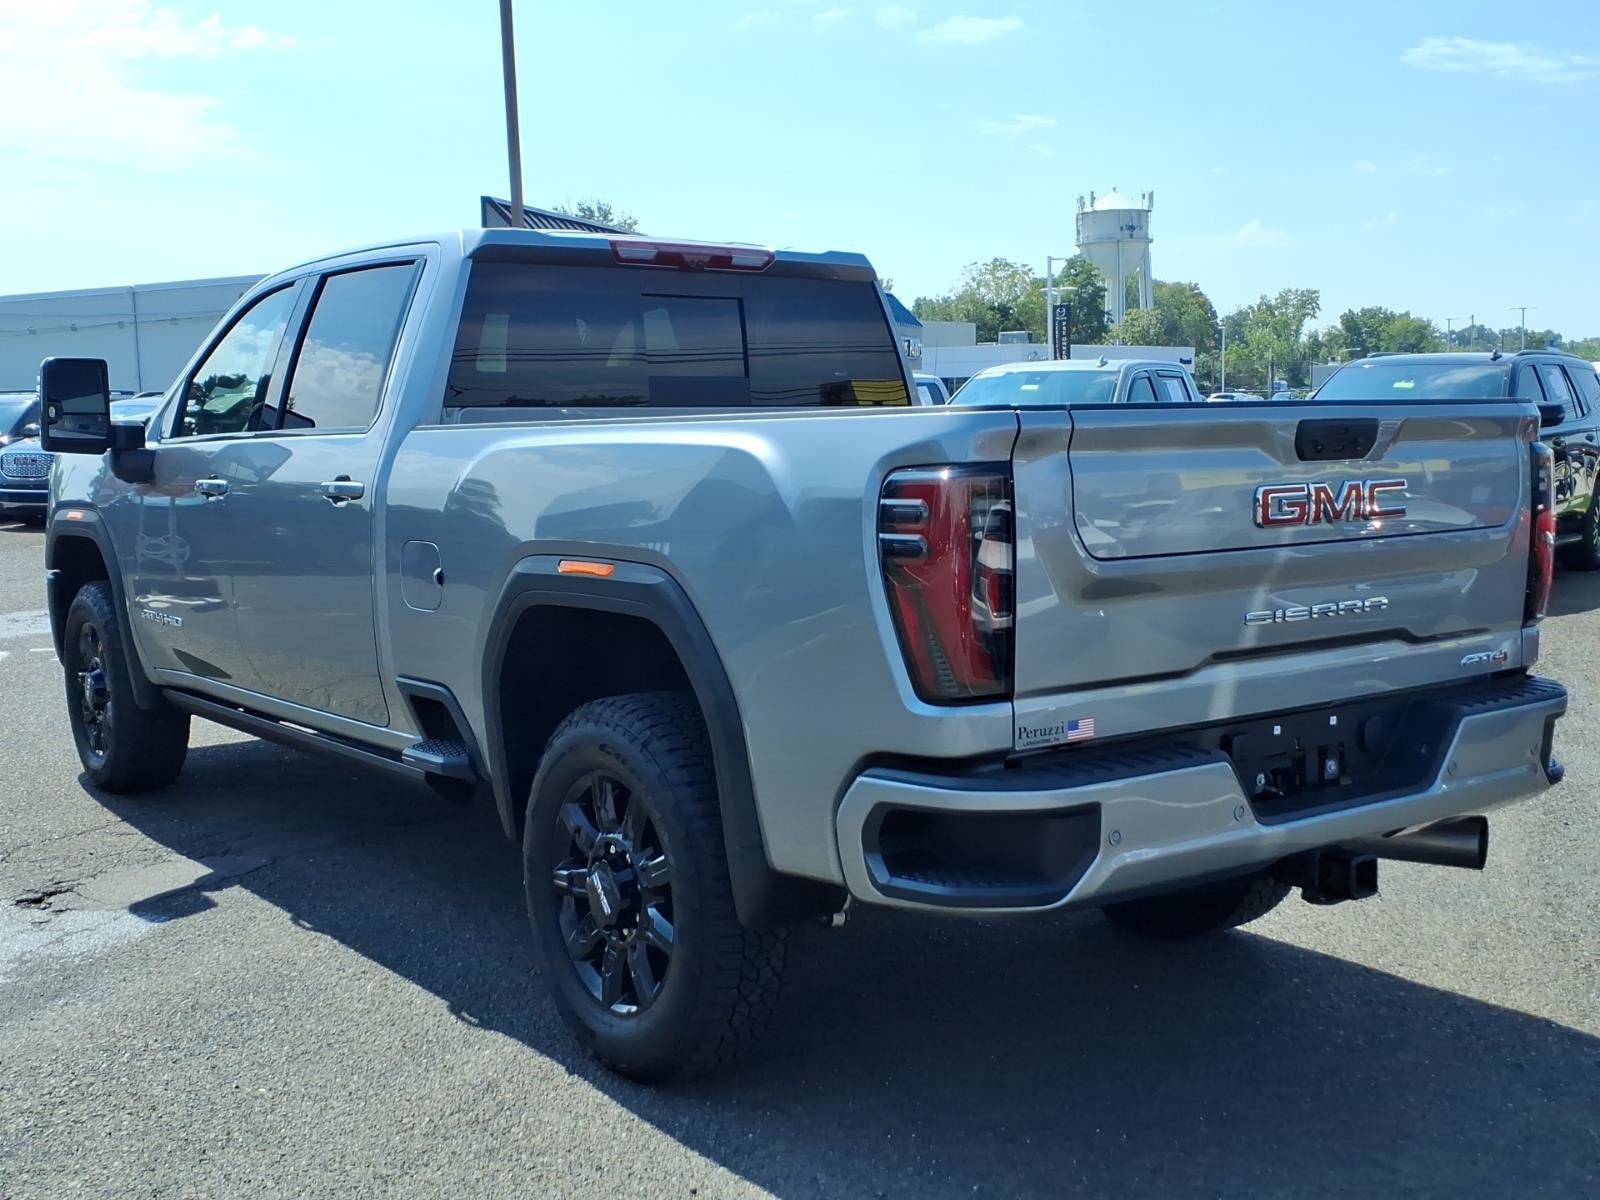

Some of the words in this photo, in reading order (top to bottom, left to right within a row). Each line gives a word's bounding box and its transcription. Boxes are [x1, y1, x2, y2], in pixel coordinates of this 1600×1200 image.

[1253, 479, 1408, 528] GMC
[1244, 596, 1389, 626] SIERRA
[1018, 721, 1065, 740] Peruzzi
